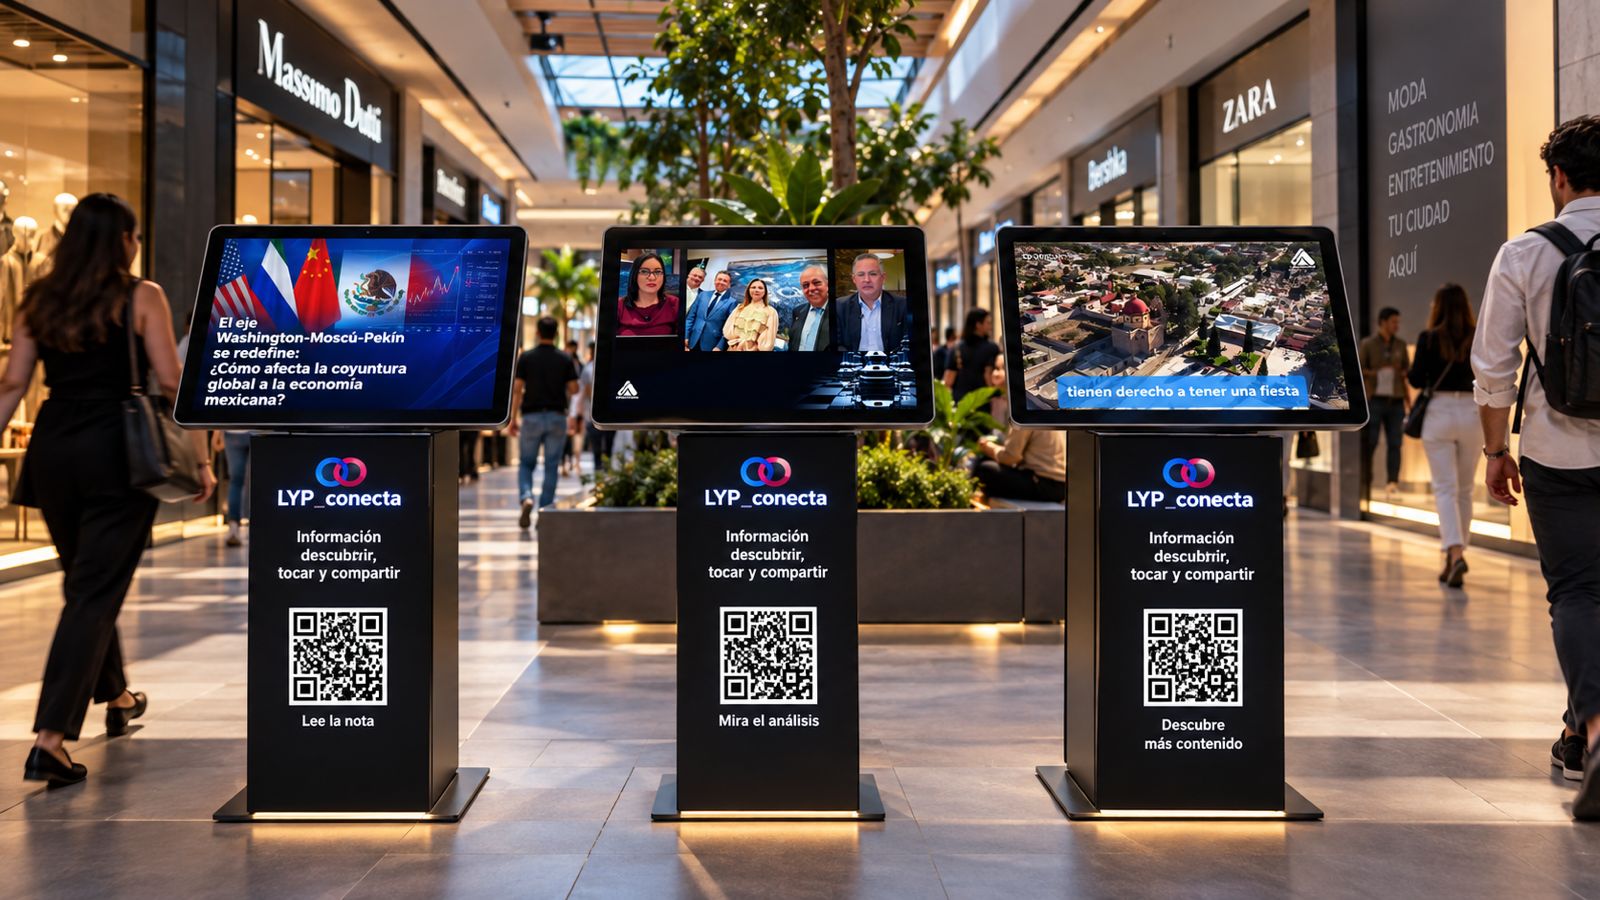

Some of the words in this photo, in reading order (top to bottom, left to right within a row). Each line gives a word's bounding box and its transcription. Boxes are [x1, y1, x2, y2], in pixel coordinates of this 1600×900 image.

[257, 18, 341, 119] Massimo
[1388, 77, 1427, 114] MODA
[1222, 78, 1277, 134] ZARA
[1388, 101, 1479, 155] GASTRONOMIA
[1388, 140, 1494, 197] ENTRETENIMIENTO
[1388, 212, 1403, 238] TU
[1406, 199, 1450, 233] CIUDAD
[1388, 244, 1418, 279] AQUÍ
[219, 317, 233, 329] El
[235, 317, 258, 331] eje
[216, 331, 405, 346] Washington-Moscú-Pekín
[213, 349, 231, 359] se
[234, 347, 300, 359] redefine:
[209, 362, 261, 376] ¿Cómo
[264, 362, 311, 375] afecta
[314, 362, 328, 375] la
[331, 364, 407, 377] coyuntura
[207, 378, 256, 393] global
[259, 381, 268, 390] a
[272, 378, 286, 390] la
[289, 377, 363, 390] economía
[1066, 385, 1112, 397] tienen
[1115, 385, 1174, 397] derecho
[1177, 388, 1186, 397] a
[1189, 386, 1227, 397] tener
[1231, 388, 1257, 397] una
[1260, 384, 1300, 397] fiesta
[204, 394, 286, 406] mexicana?
[277, 489, 402, 509] LYP_conecta
[704, 489, 828, 509] LYP_conecta
[1127, 490, 1254, 510] LYP_conecta
[297, 529, 382, 544] Información
[726, 529, 809, 543] Información
[1149, 530, 1235, 545] Información
[277, 566, 316, 580] tocar
[319, 569, 328, 583] y
[331, 565, 401, 583] compartir
[708, 566, 745, 579] tocar
[748, 568, 757, 582] y
[760, 565, 829, 582] compartir
[1130, 567, 1169, 581] tocar
[1172, 570, 1182, 584] y
[1184, 566, 1255, 584] compartir
[302, 714, 326, 727] Lee
[329, 714, 342, 727] la
[344, 715, 375, 727] nota
[718, 713, 749, 727] Mira
[752, 713, 765, 727] el
[768, 713, 820, 727] análisis
[1161, 718, 1226, 731] Descubre
[1144, 736, 1173, 750] más
[1175, 736, 1243, 750] contenido
